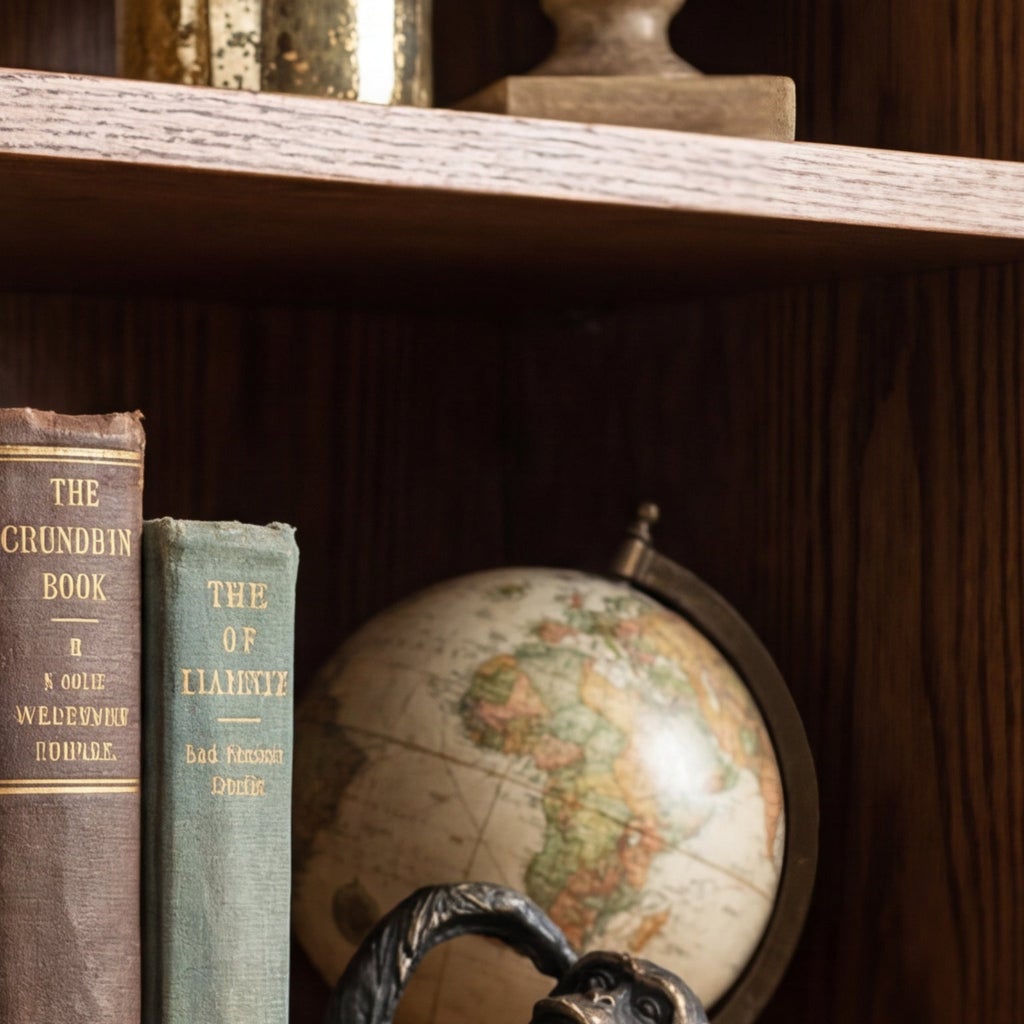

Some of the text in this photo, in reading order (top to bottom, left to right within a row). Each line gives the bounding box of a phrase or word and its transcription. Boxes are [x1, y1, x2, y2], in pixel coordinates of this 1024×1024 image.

[50, 478, 100, 507] THE
[42, 571, 107, 601] BOOK
[207, 580, 268, 610] THE
[222, 626, 257, 653] OF
